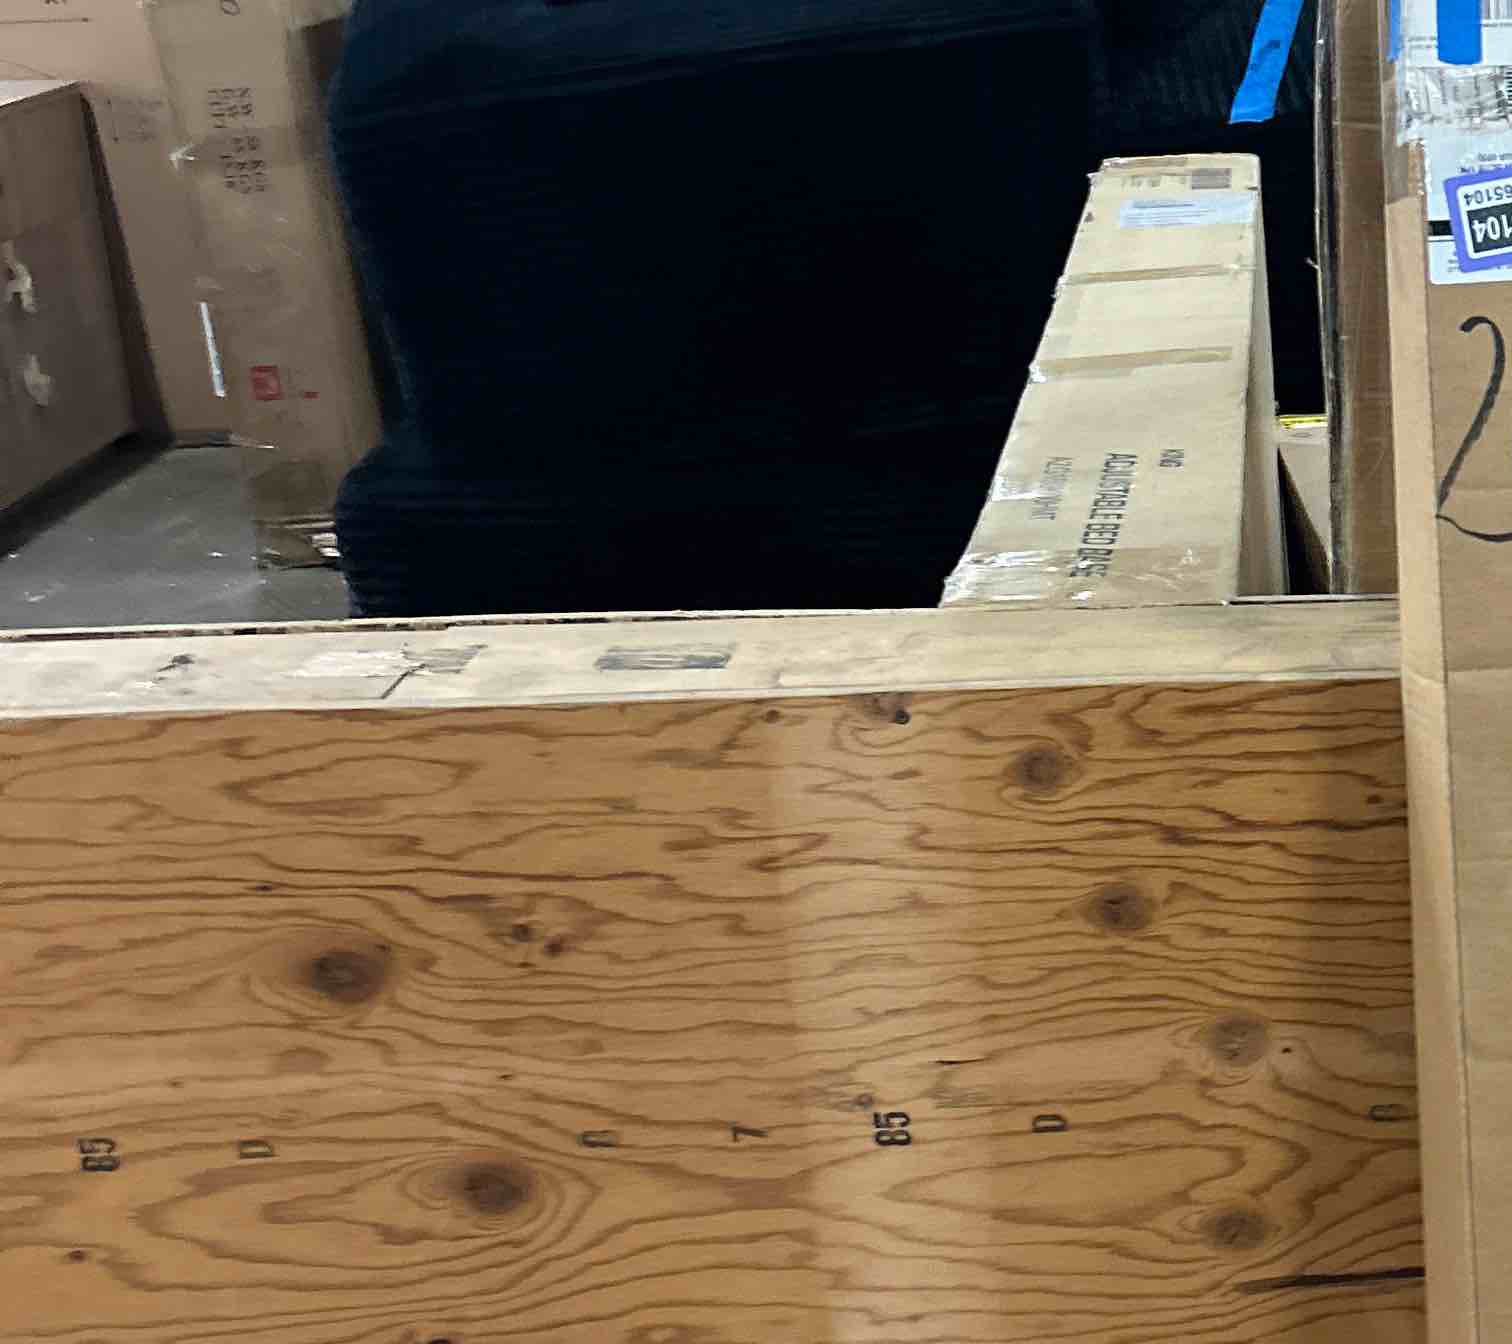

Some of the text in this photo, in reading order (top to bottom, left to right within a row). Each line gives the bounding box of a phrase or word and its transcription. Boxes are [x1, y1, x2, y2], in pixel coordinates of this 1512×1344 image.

[1089, 452, 1138, 520] ADJUSTABLE
[1081, 522, 1121, 545] BED
[873, 1109, 912, 1147] 85
